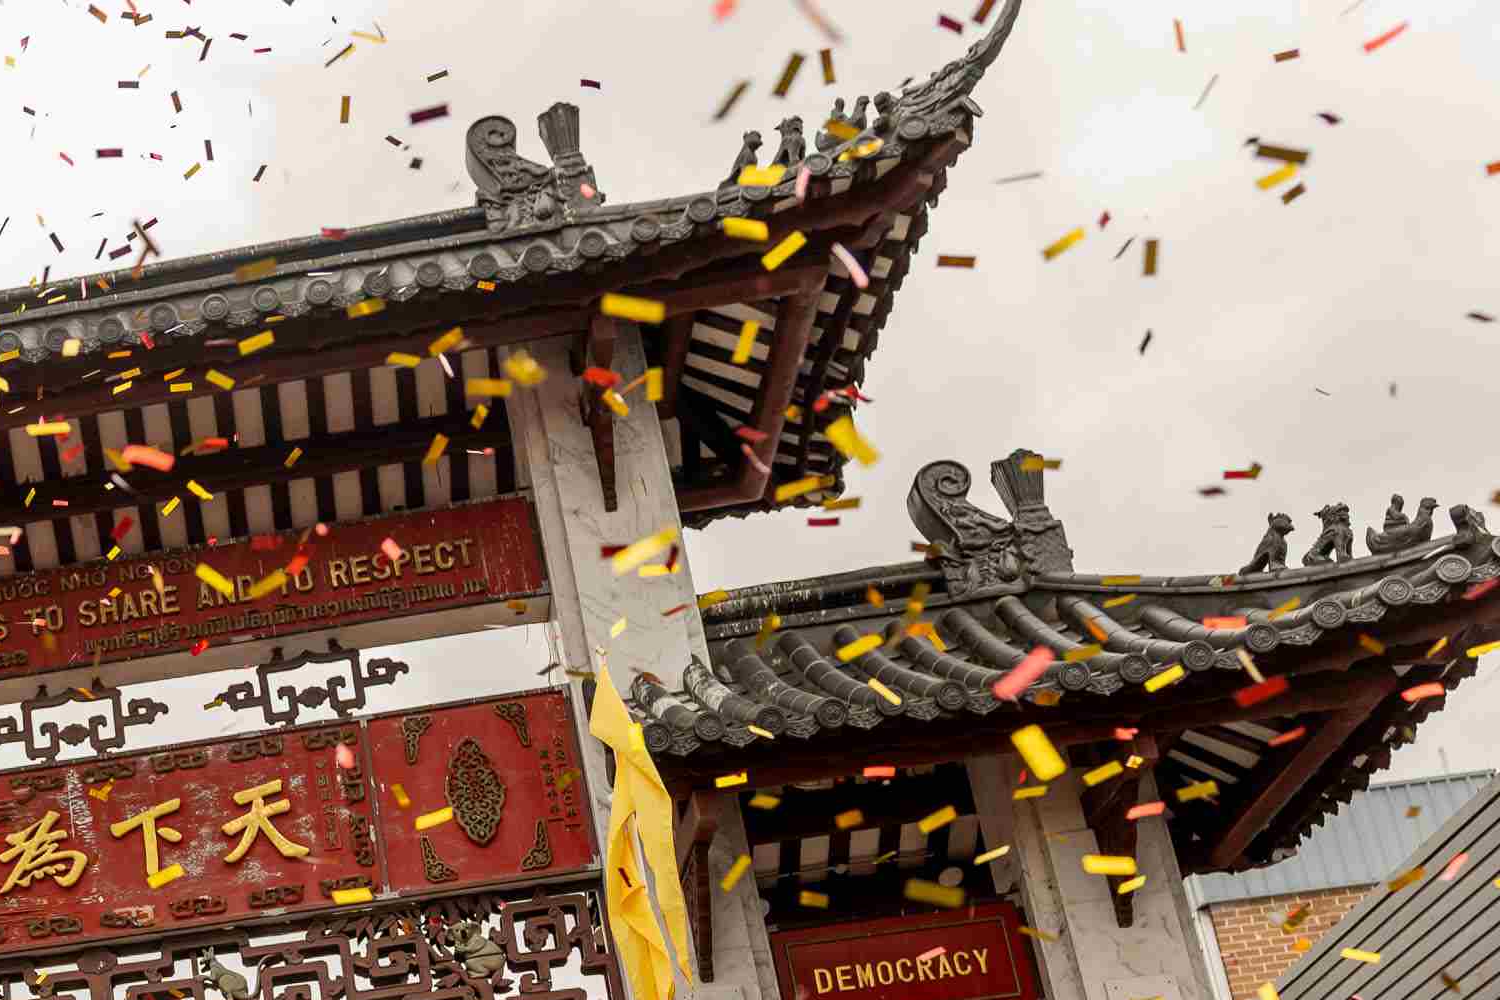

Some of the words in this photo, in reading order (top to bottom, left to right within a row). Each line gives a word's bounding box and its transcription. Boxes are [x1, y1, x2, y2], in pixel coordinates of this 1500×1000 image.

[24, 603, 64, 636] TO
[77, 585, 181, 628] SHARE
[328, 537, 476, 590] RESPECT
[813, 948, 990, 995] DEMOCRACY
